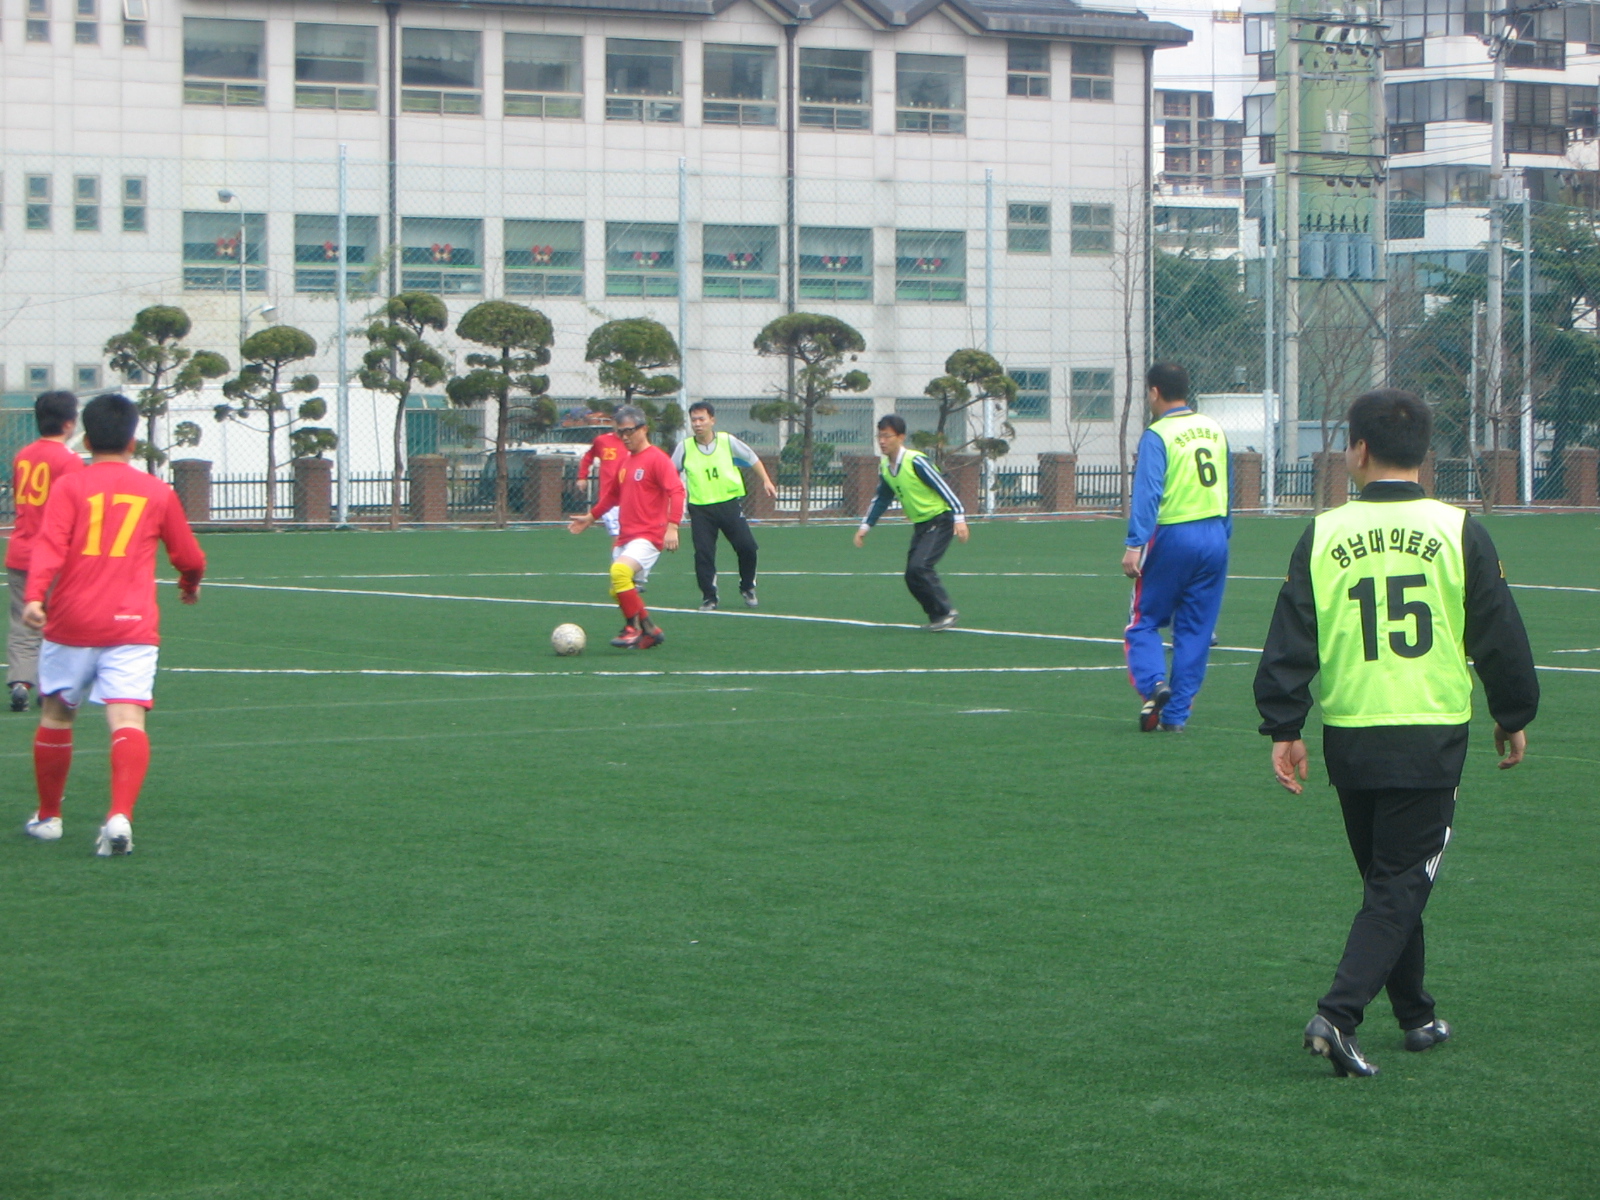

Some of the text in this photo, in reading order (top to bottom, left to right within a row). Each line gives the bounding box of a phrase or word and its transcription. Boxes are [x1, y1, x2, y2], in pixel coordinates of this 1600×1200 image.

[602, 447, 617, 461] 25
[705, 467, 719, 481] 14
[1194, 447, 1218, 488] 6
[16, 460, 50, 506] 29
[81, 492, 148, 557] 17
[1331, 527, 1443, 569] 영남대의료원
[1348, 573, 1433, 662] 15
